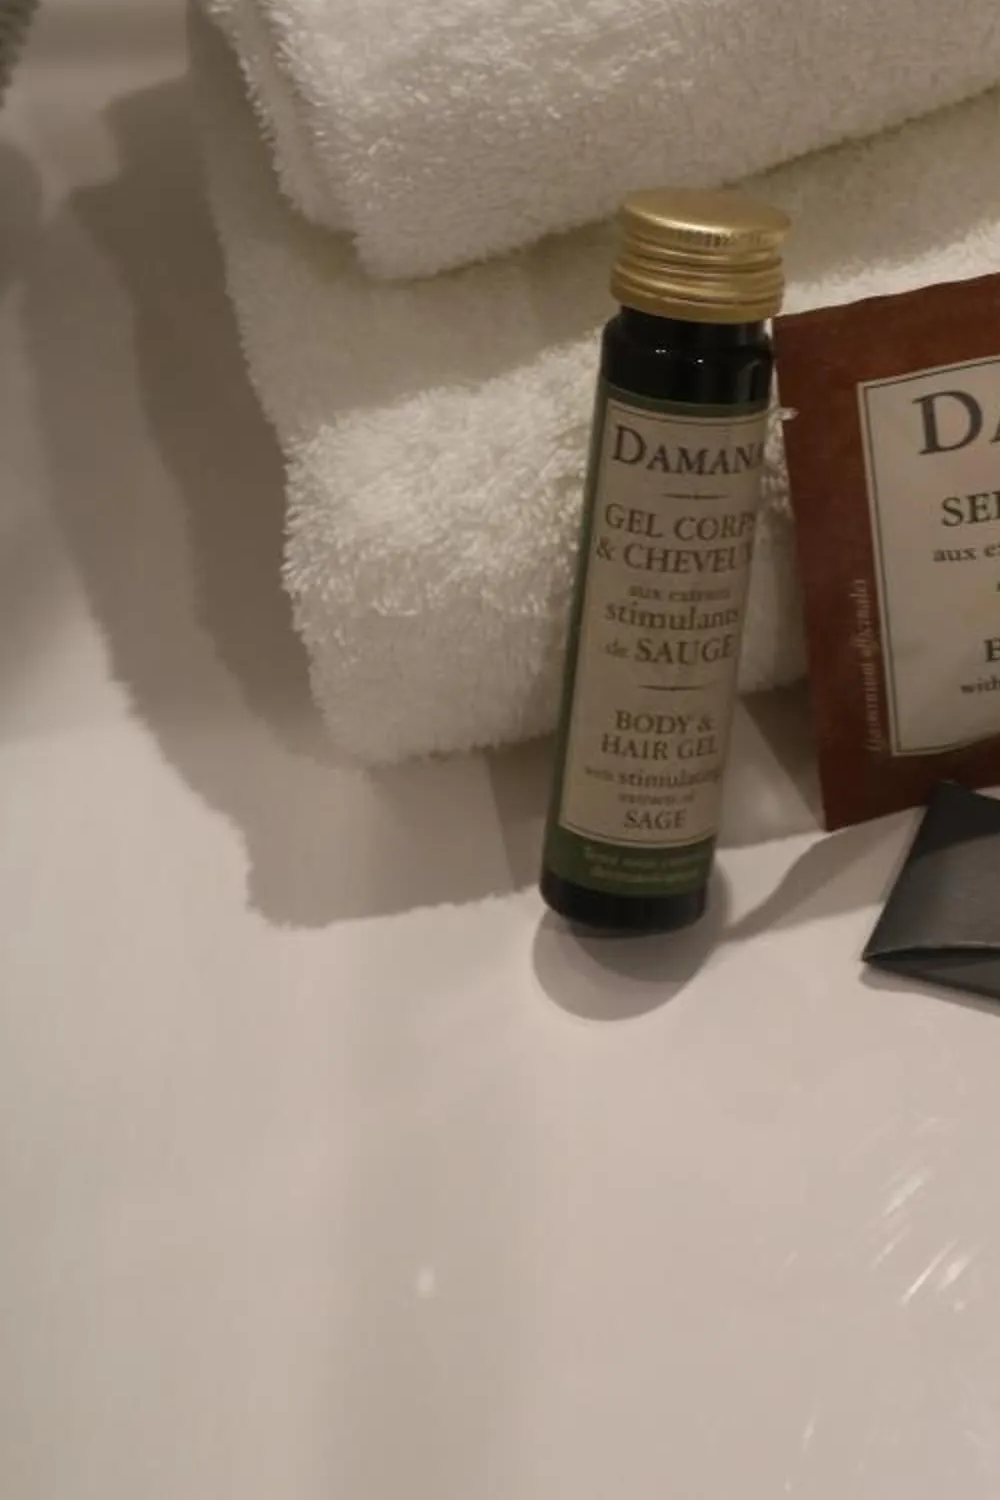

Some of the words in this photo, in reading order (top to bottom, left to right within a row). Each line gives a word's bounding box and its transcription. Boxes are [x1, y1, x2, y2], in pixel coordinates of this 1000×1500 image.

[611, 424, 765, 476] DAMAN
[605, 503, 663, 538] GEL
[673, 511, 755, 542] CORP
[596, 537, 616, 561] &
[933, 547, 977, 563] aux
[634, 633, 735, 666] SAUGE
[615, 709, 691, 736] BODY
[696, 713, 715, 732] &
[601, 732, 668, 760] HAIR
[676, 735, 718, 760] GEL
[623, 809, 687, 830] SAGE
